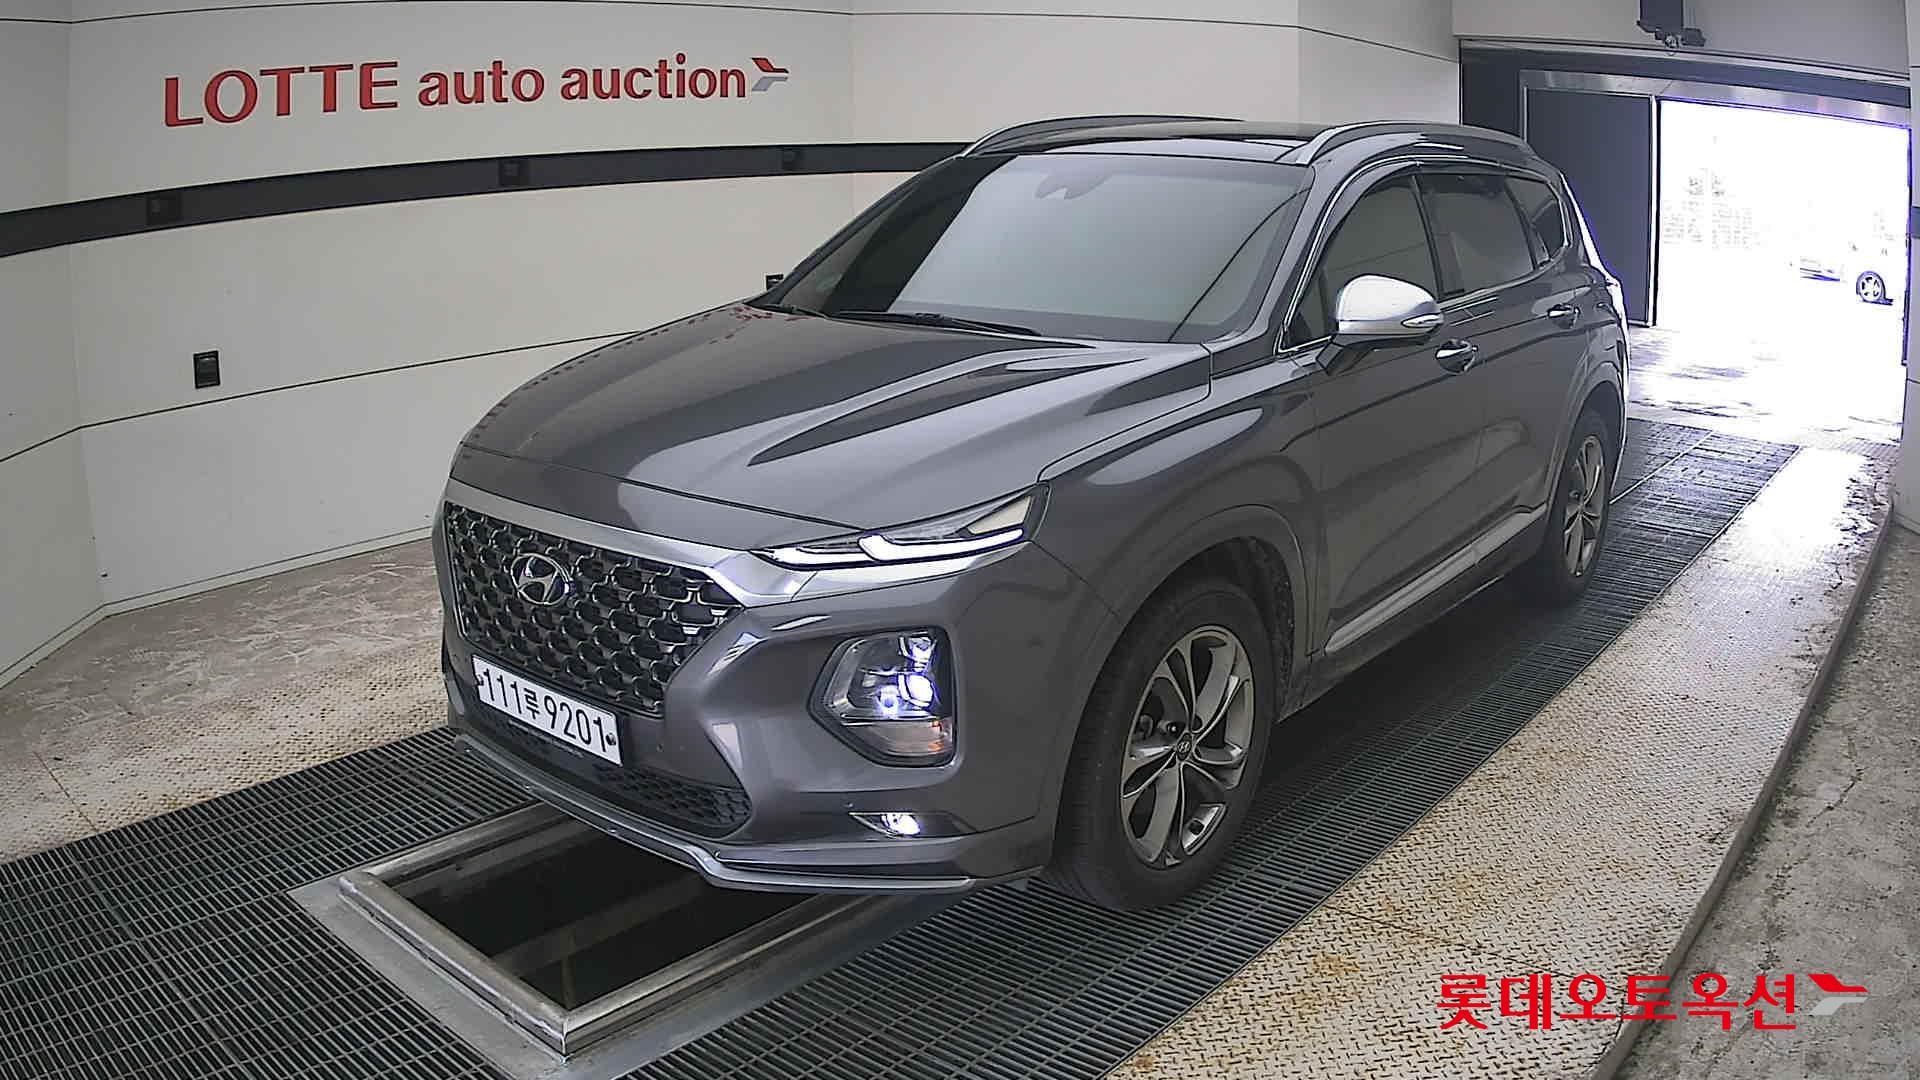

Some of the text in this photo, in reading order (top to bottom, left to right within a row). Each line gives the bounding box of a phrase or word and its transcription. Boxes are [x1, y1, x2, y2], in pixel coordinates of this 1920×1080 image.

[164, 53, 748, 127] LOTTE auto auction
